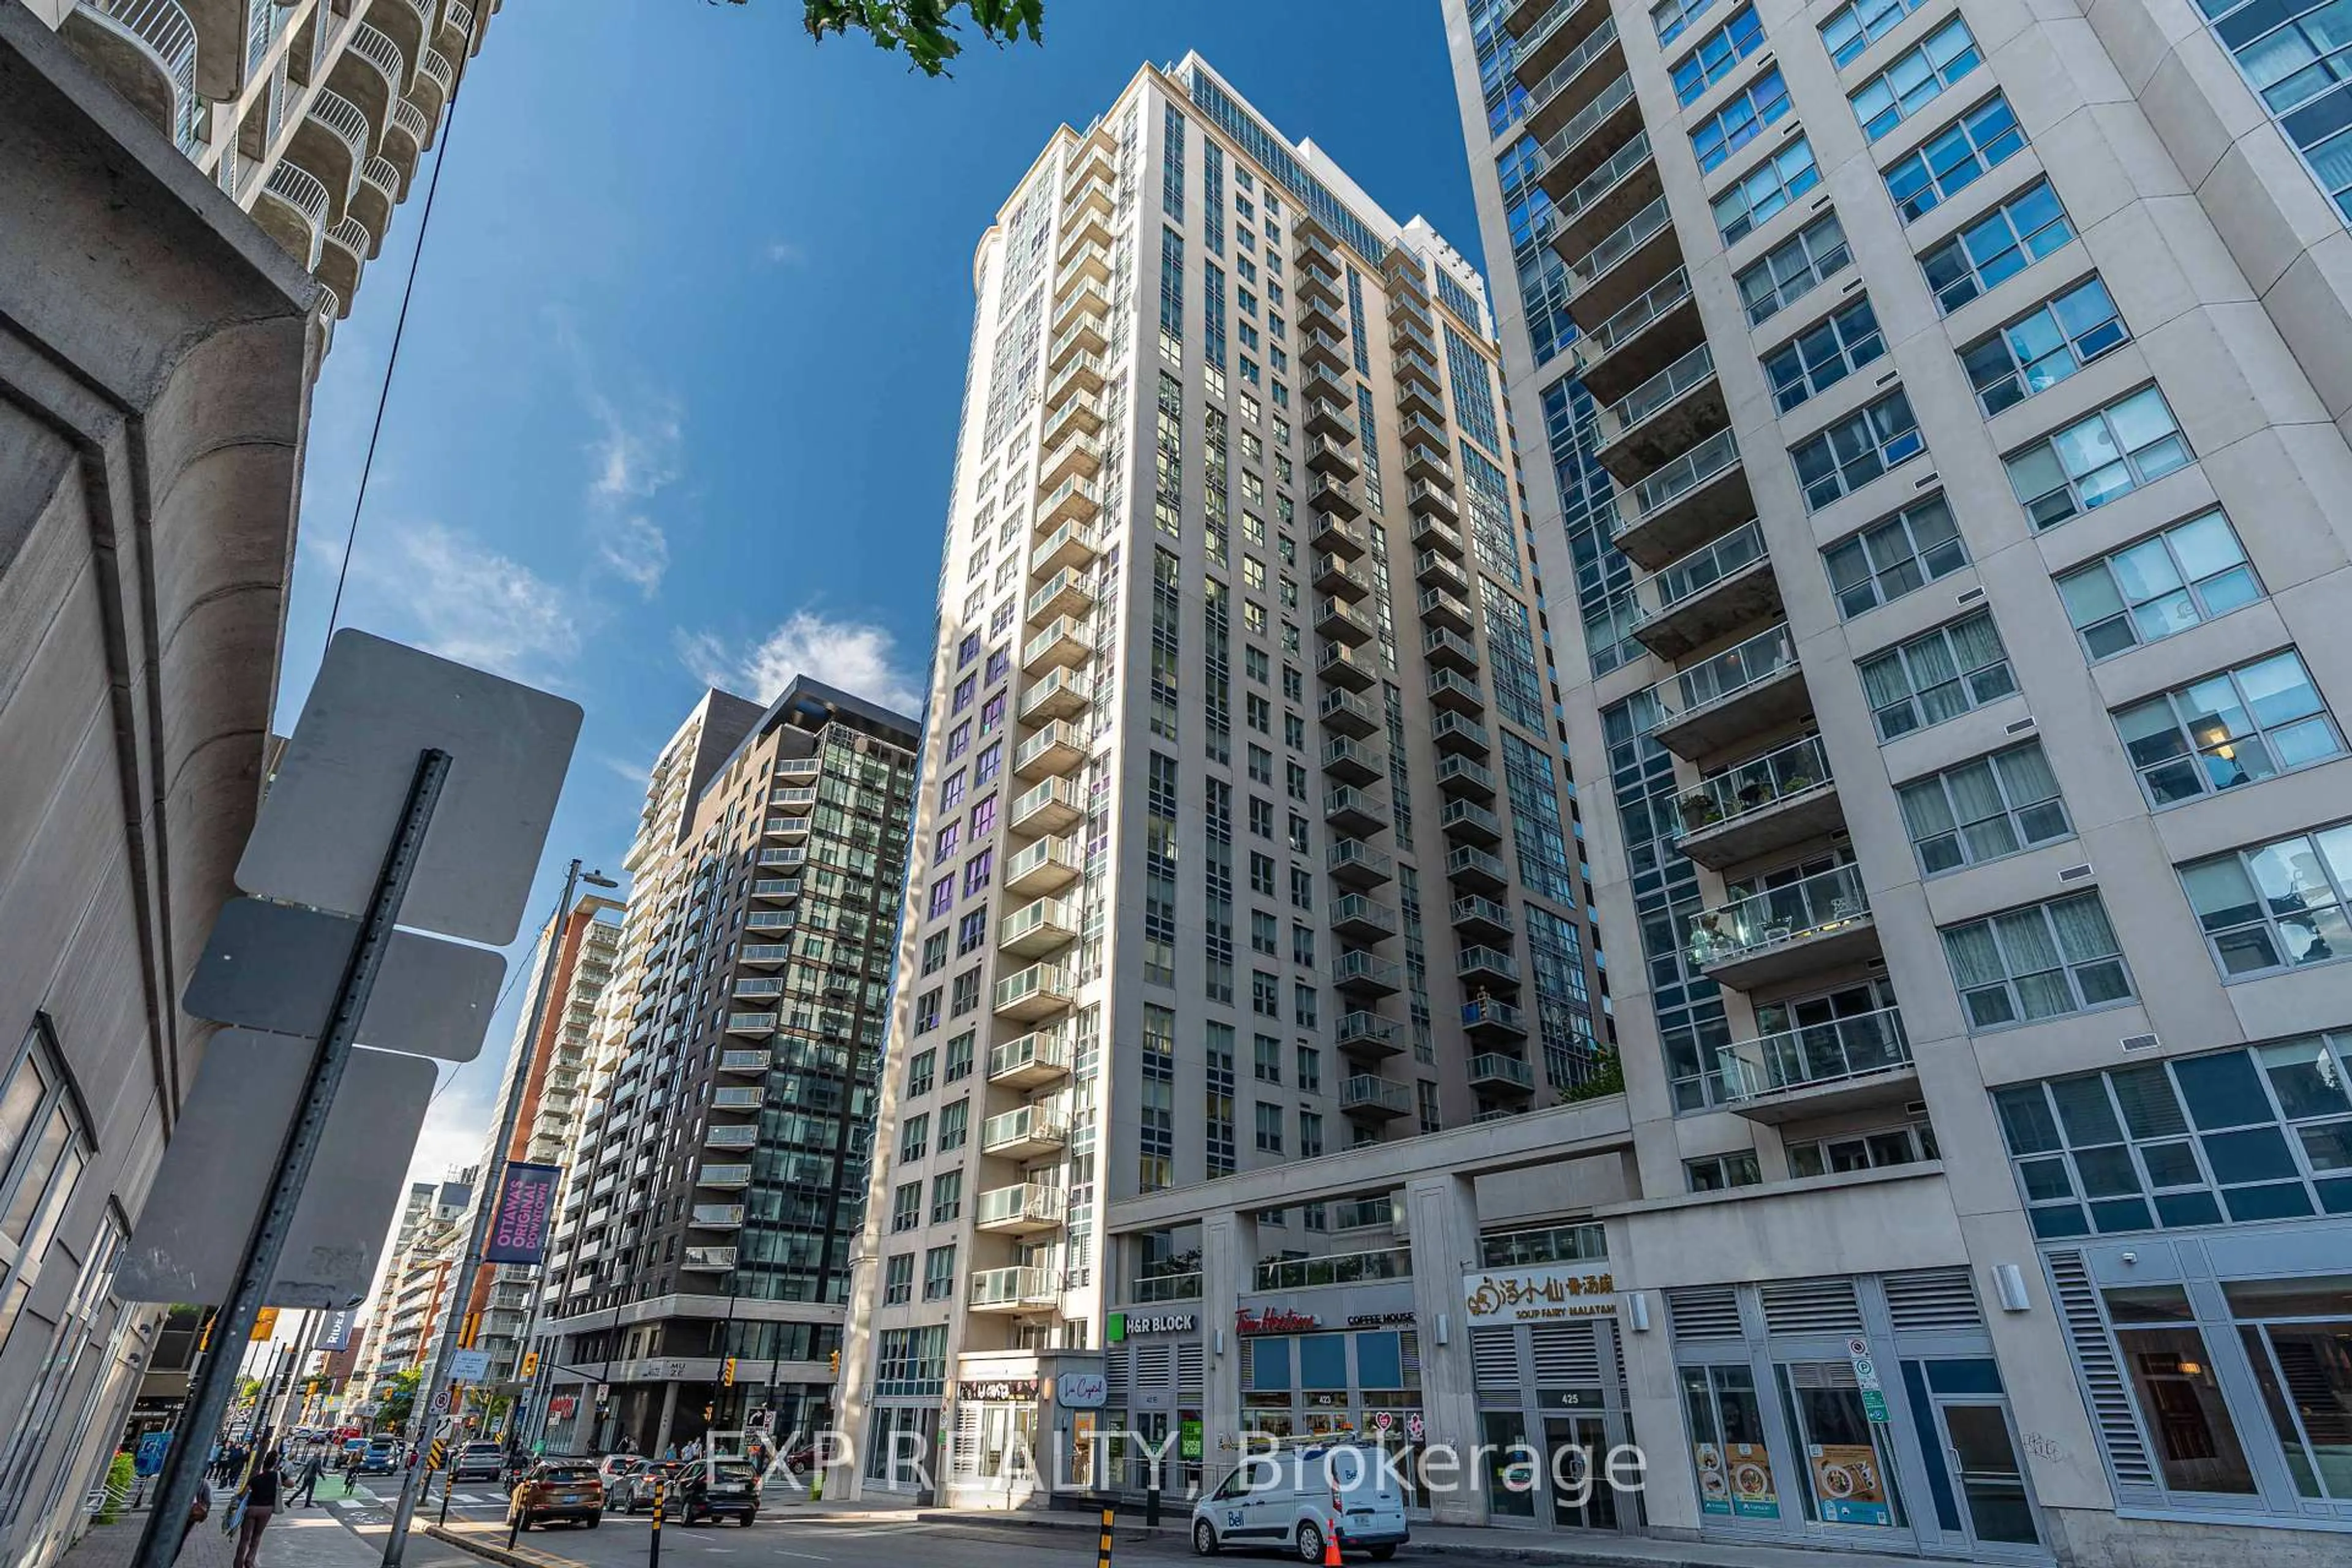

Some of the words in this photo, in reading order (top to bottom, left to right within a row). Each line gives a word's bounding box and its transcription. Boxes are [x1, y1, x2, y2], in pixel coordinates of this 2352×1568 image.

[497, 1179, 524, 1246] OTTAWA'S
[512, 1182, 537, 1248] ORIGINAL
[526, 1183, 550, 1249] DOWNTOWN
[1348, 1314, 1382, 1325] COFFEE
[1383, 1312, 1417, 1324] HOUSE
[1516, 1310, 1540, 1319] SOUP
[1542, 1308, 1566, 1317] FAIRY
[1126, 1319, 1150, 1334] H&R
[1152, 1314, 1193, 1332] BLOCK
[1562, 1394, 1578, 1404] 425
[1228, 1510, 1245, 1527] Bell
